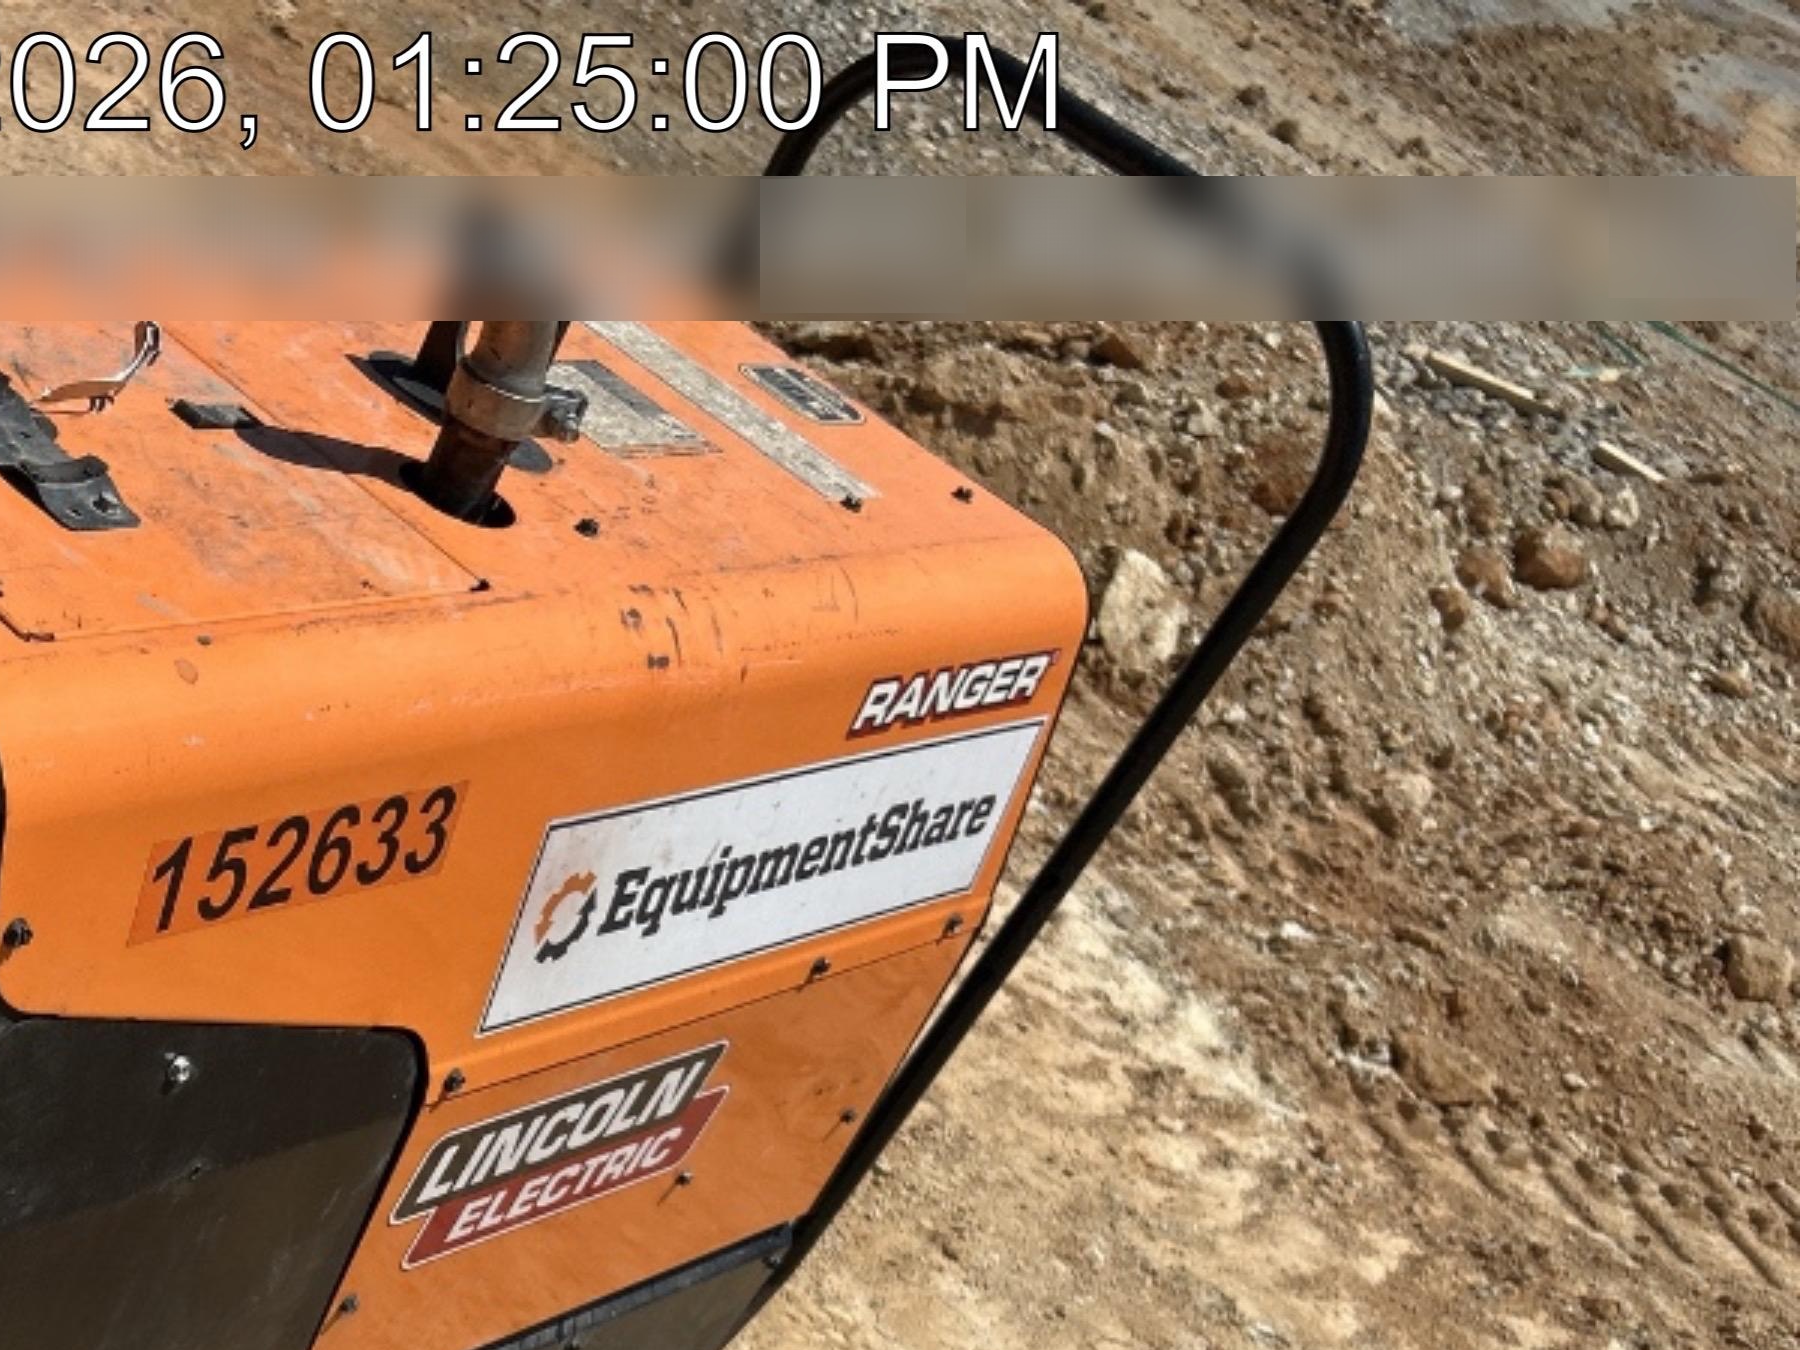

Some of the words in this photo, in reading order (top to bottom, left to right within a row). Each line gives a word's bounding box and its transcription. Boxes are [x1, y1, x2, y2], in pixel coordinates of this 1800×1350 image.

[848, 652, 1053, 735] RANGER
[153, 785, 457, 933] 152633
[597, 794, 997, 939] EquipmentShare
[416, 1060, 705, 1204] LINCOLN
[444, 1126, 684, 1243] ELECTRIC
